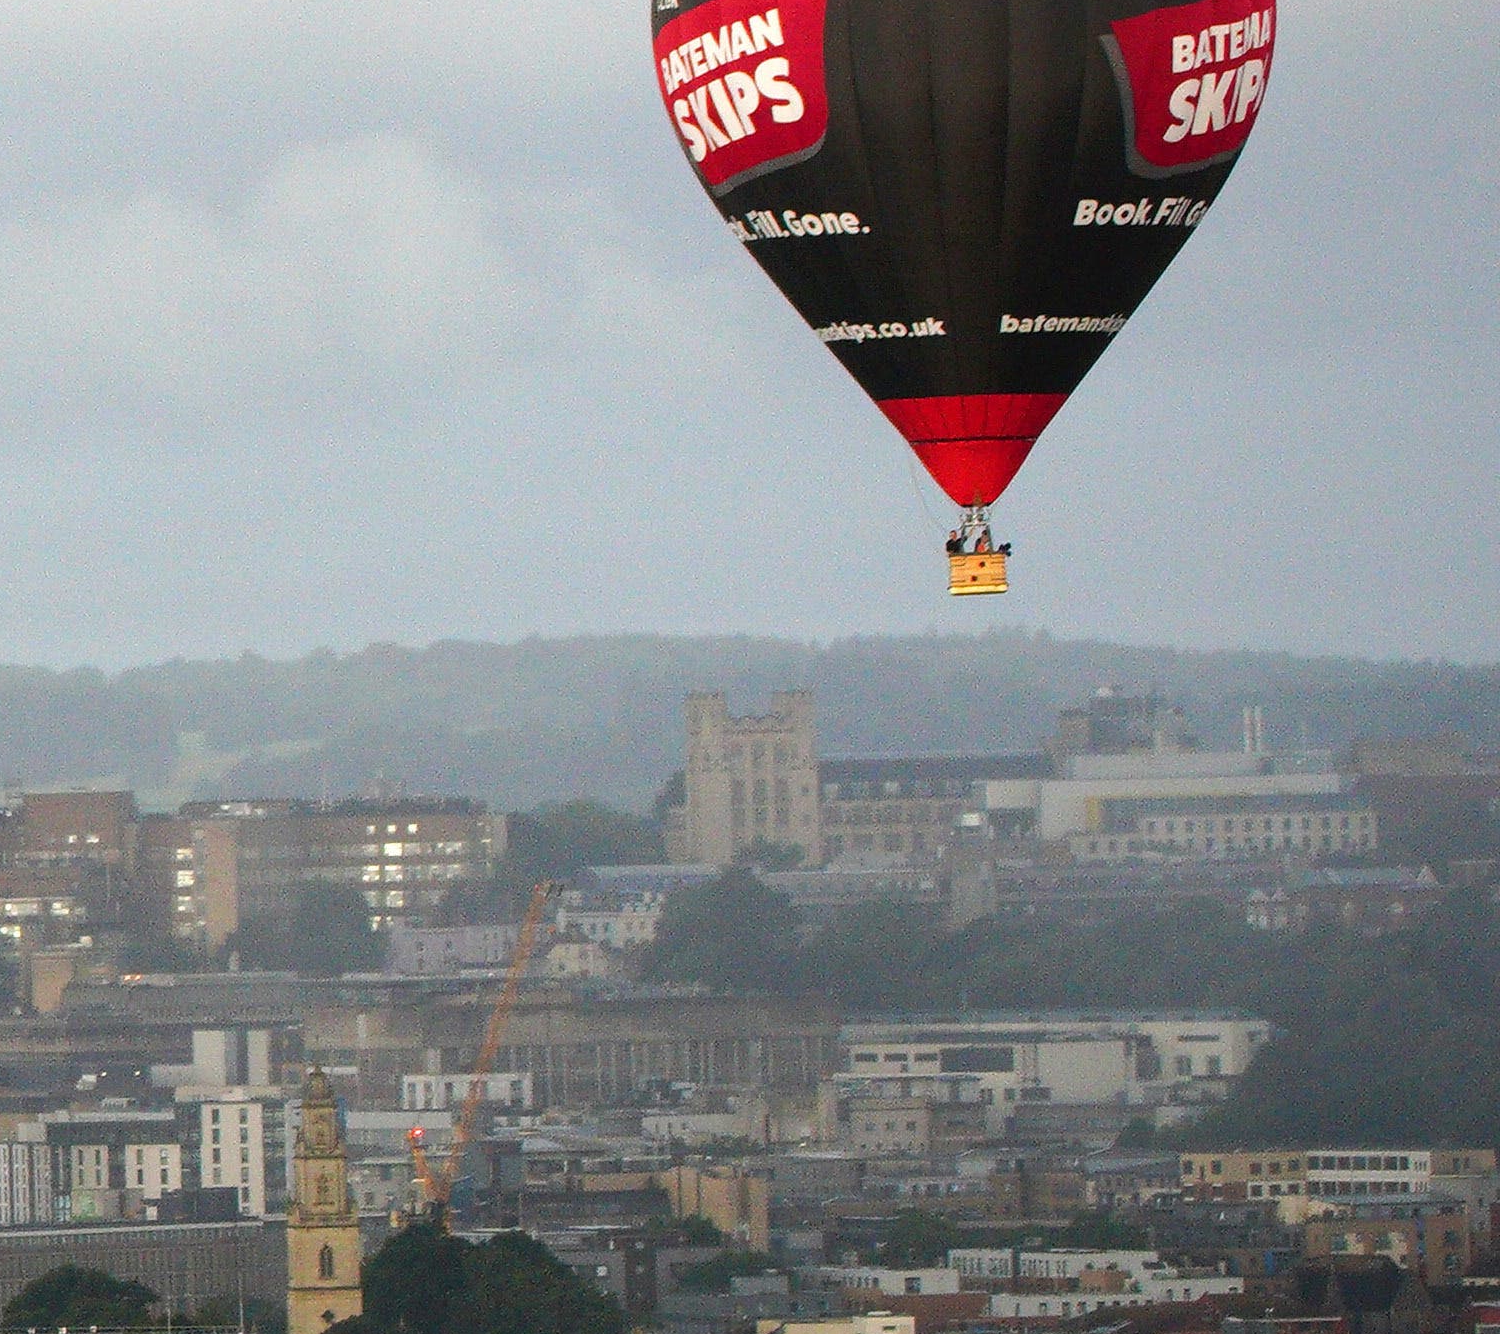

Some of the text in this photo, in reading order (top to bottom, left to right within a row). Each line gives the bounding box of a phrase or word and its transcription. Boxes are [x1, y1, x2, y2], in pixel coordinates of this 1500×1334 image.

[660, 8, 785, 96] BATEMAN
[1172, 7, 1274, 75] BATEMA
[673, 56, 805, 162] SKIPS
